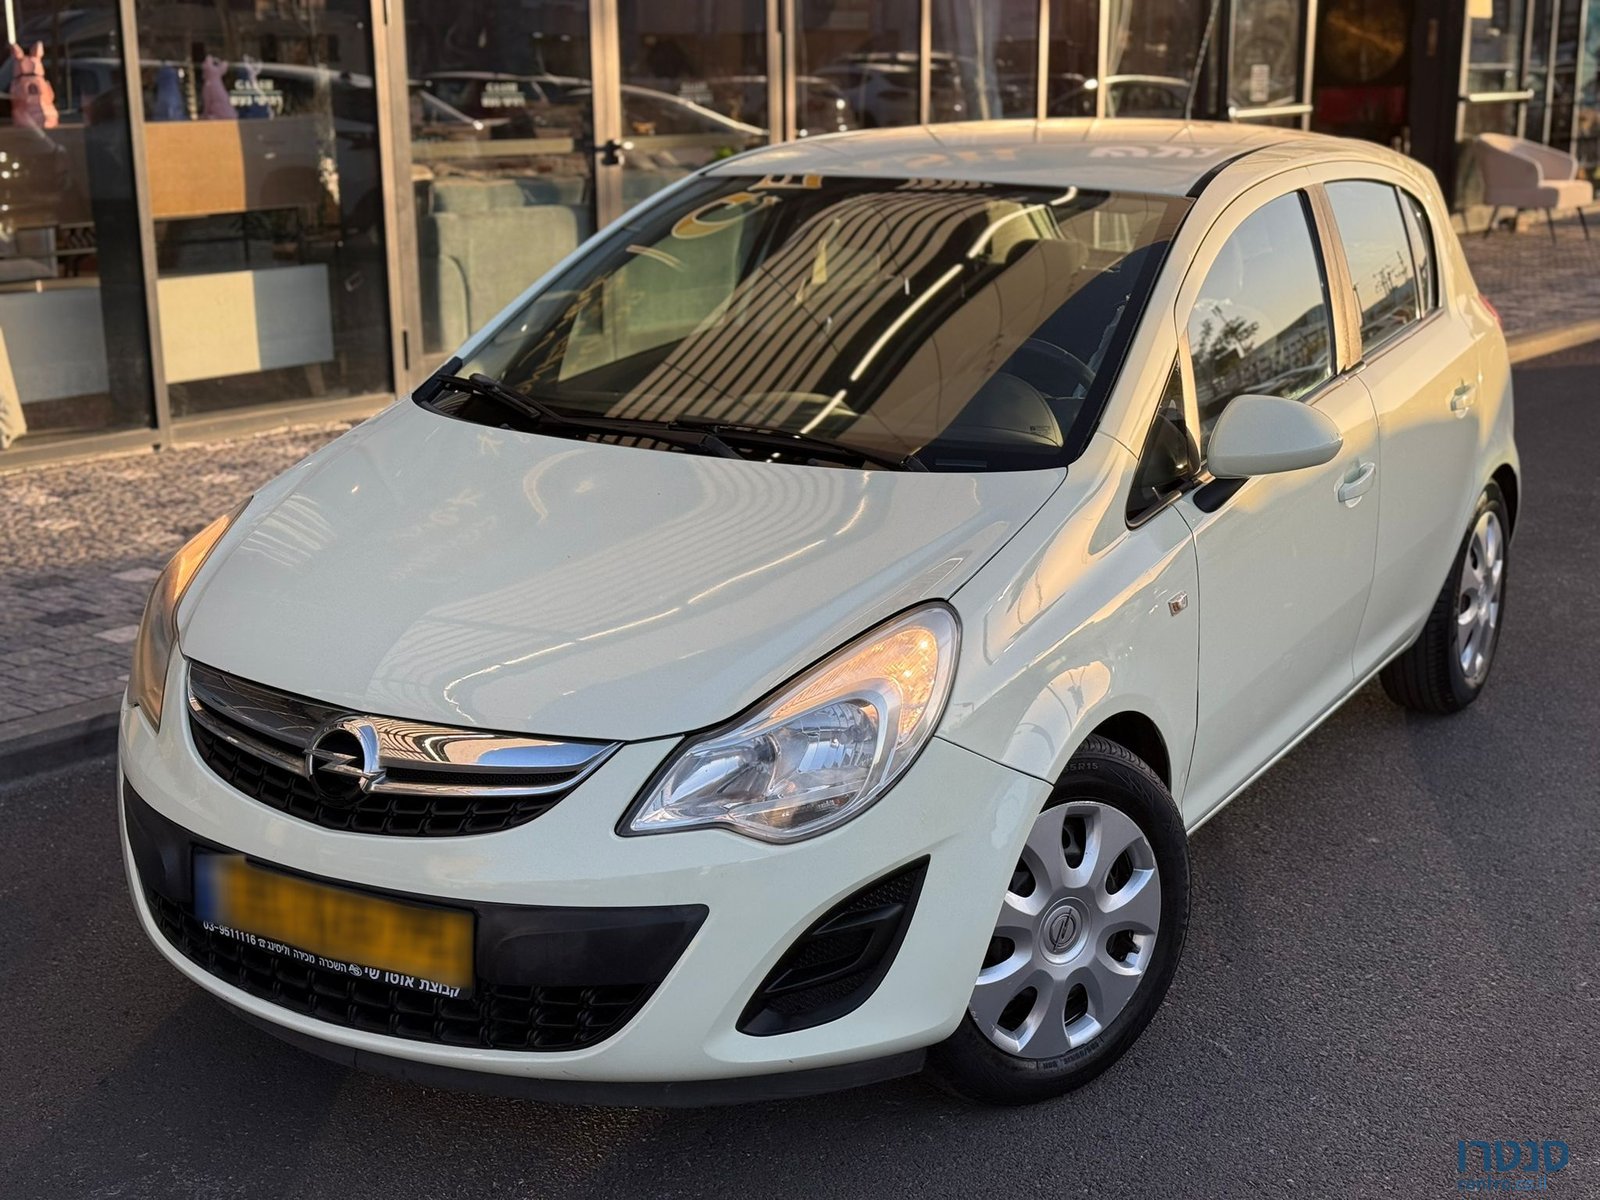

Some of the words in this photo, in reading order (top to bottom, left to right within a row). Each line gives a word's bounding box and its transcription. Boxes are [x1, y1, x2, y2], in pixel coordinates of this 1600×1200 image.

[203, 920, 257, 945] 03-9511116
[267, 940, 290, 956] וליסינג
[292, 949, 315, 964] מכירה
[318, 957, 347, 973] השכרה
[364, 966, 380, 980] שי
[384, 971, 415, 988] אוטו
[419, 979, 460, 998] קבוצת
